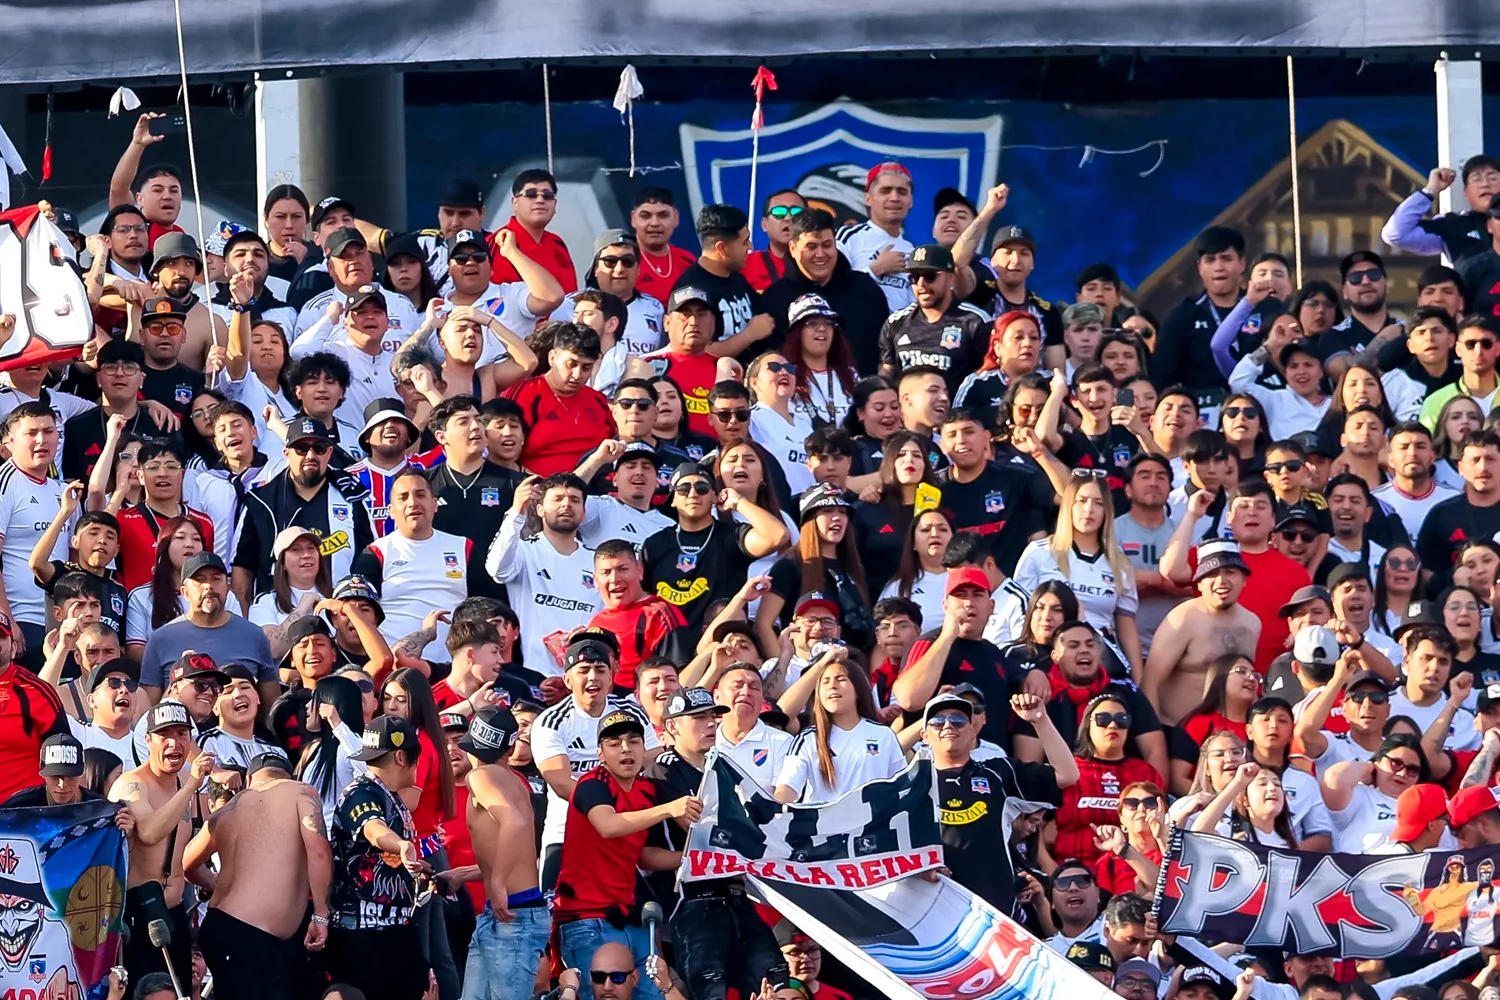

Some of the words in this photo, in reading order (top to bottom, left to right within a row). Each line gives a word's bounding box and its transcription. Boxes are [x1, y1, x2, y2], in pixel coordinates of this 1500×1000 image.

[627, 338, 656, 353] lsen
[898, 351, 952, 372] Pilsen
[659, 581, 704, 602] CRISTAL
[547, 595, 576, 610] JUGA
[576, 601, 596, 613] BET
[155, 705, 188, 726] ACIDOSIS
[45, 745, 78, 765] ACIDOSIS
[940, 806, 983, 823] RISTAL
[785, 861, 828, 886] LA
[1161, 828, 1431, 959] PKS
